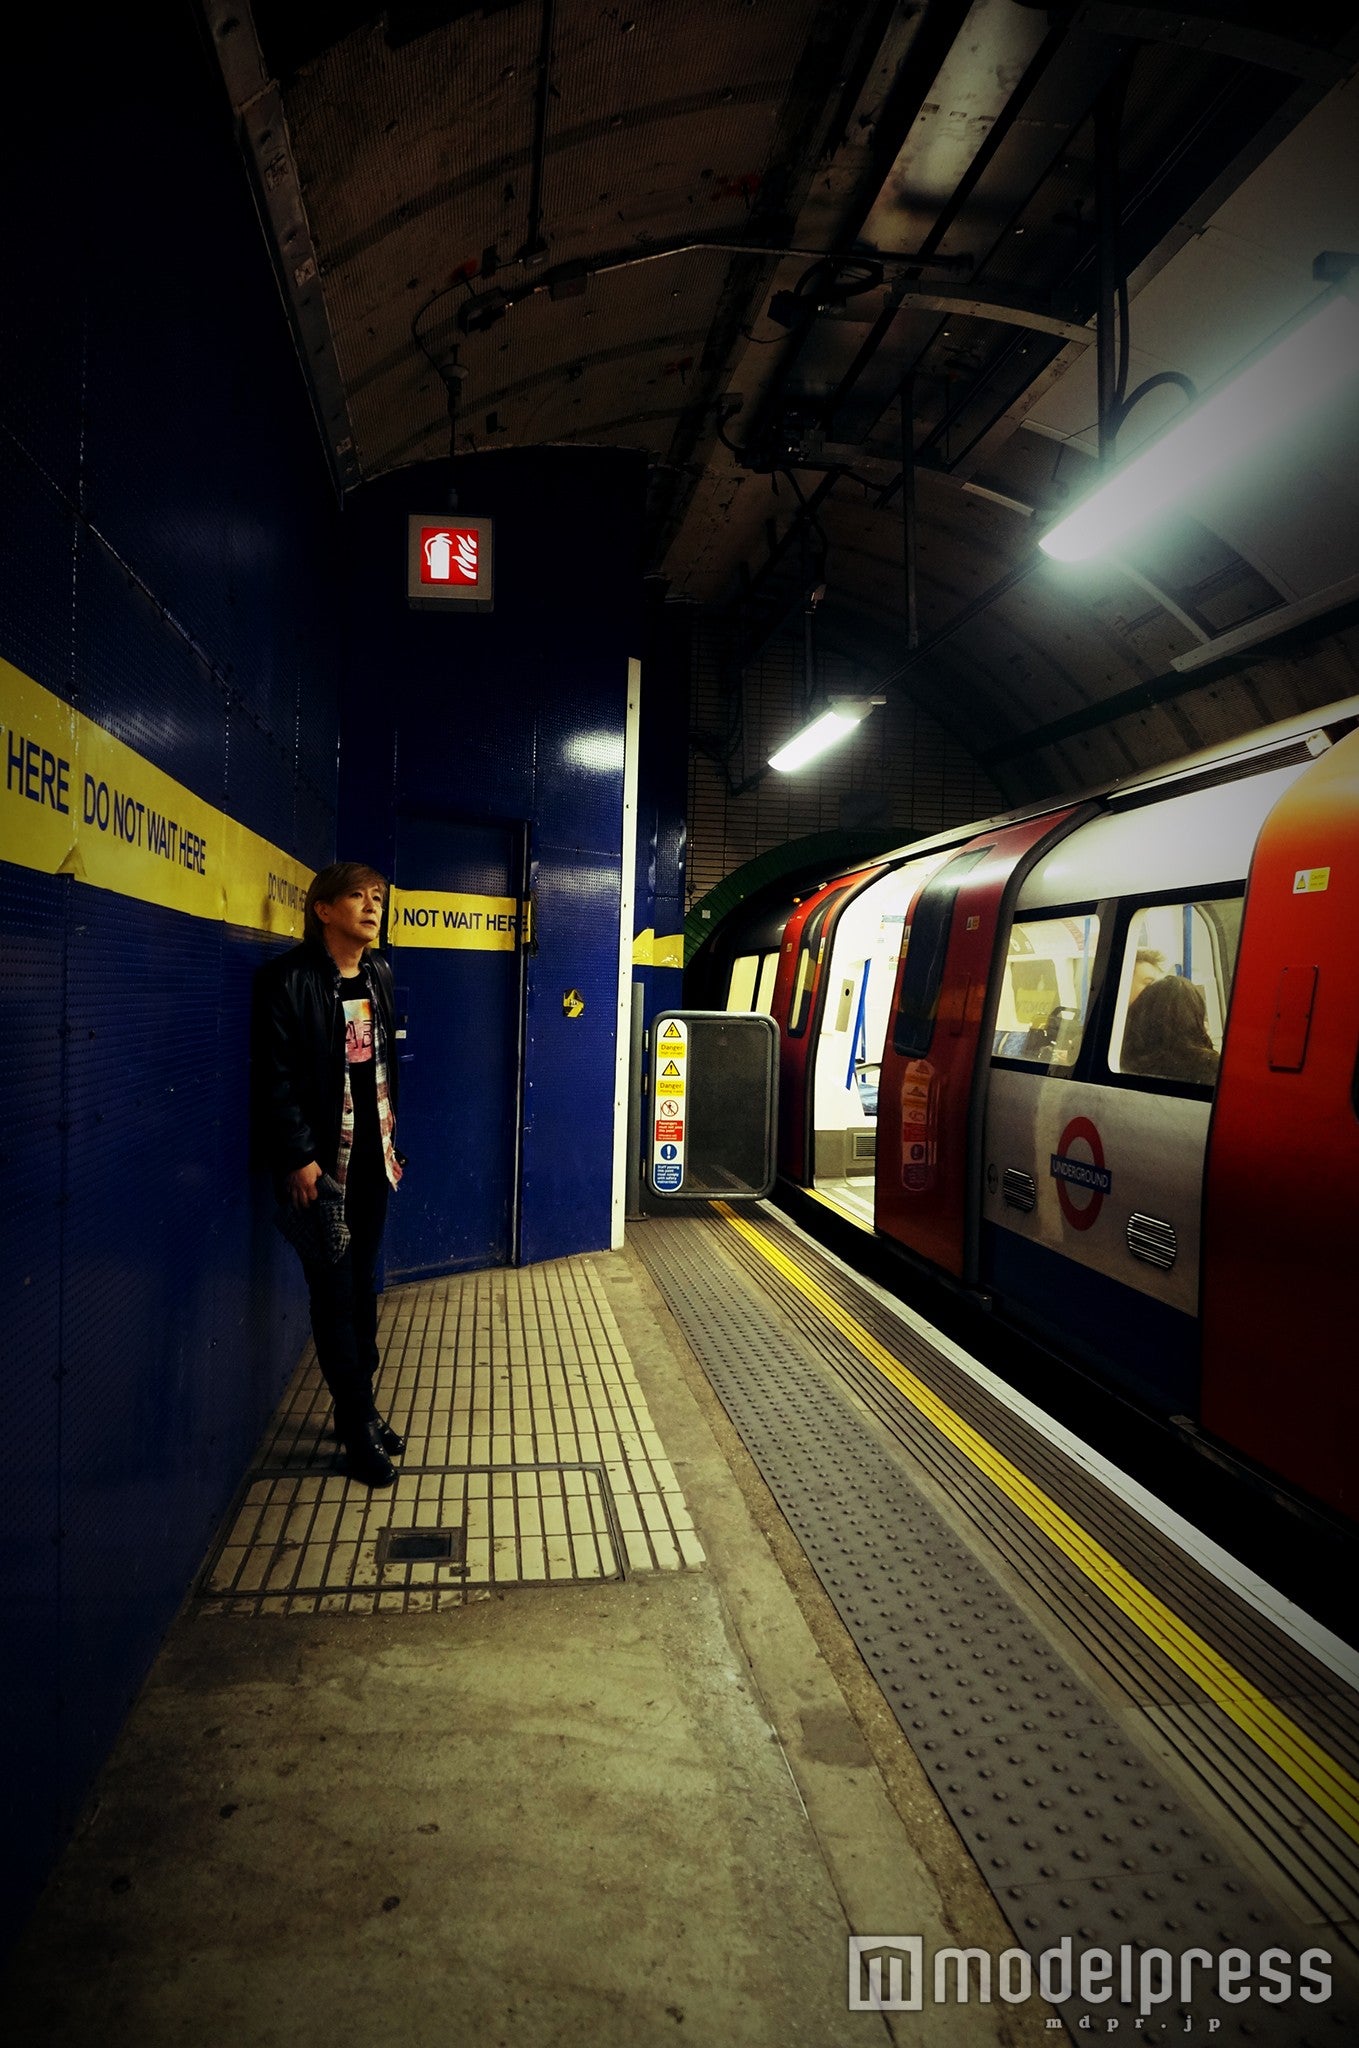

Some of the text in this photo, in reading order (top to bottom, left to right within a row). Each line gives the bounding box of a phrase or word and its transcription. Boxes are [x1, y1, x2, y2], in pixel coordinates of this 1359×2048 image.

[7, 730, 69, 815] HERE
[84, 773, 207, 876] DO NOT WAIT HERE
[403, 908, 439, 927] NOT
[443, 911, 483, 930] WAIT
[1052, 1157, 1109, 1188] UNDERGROUND
